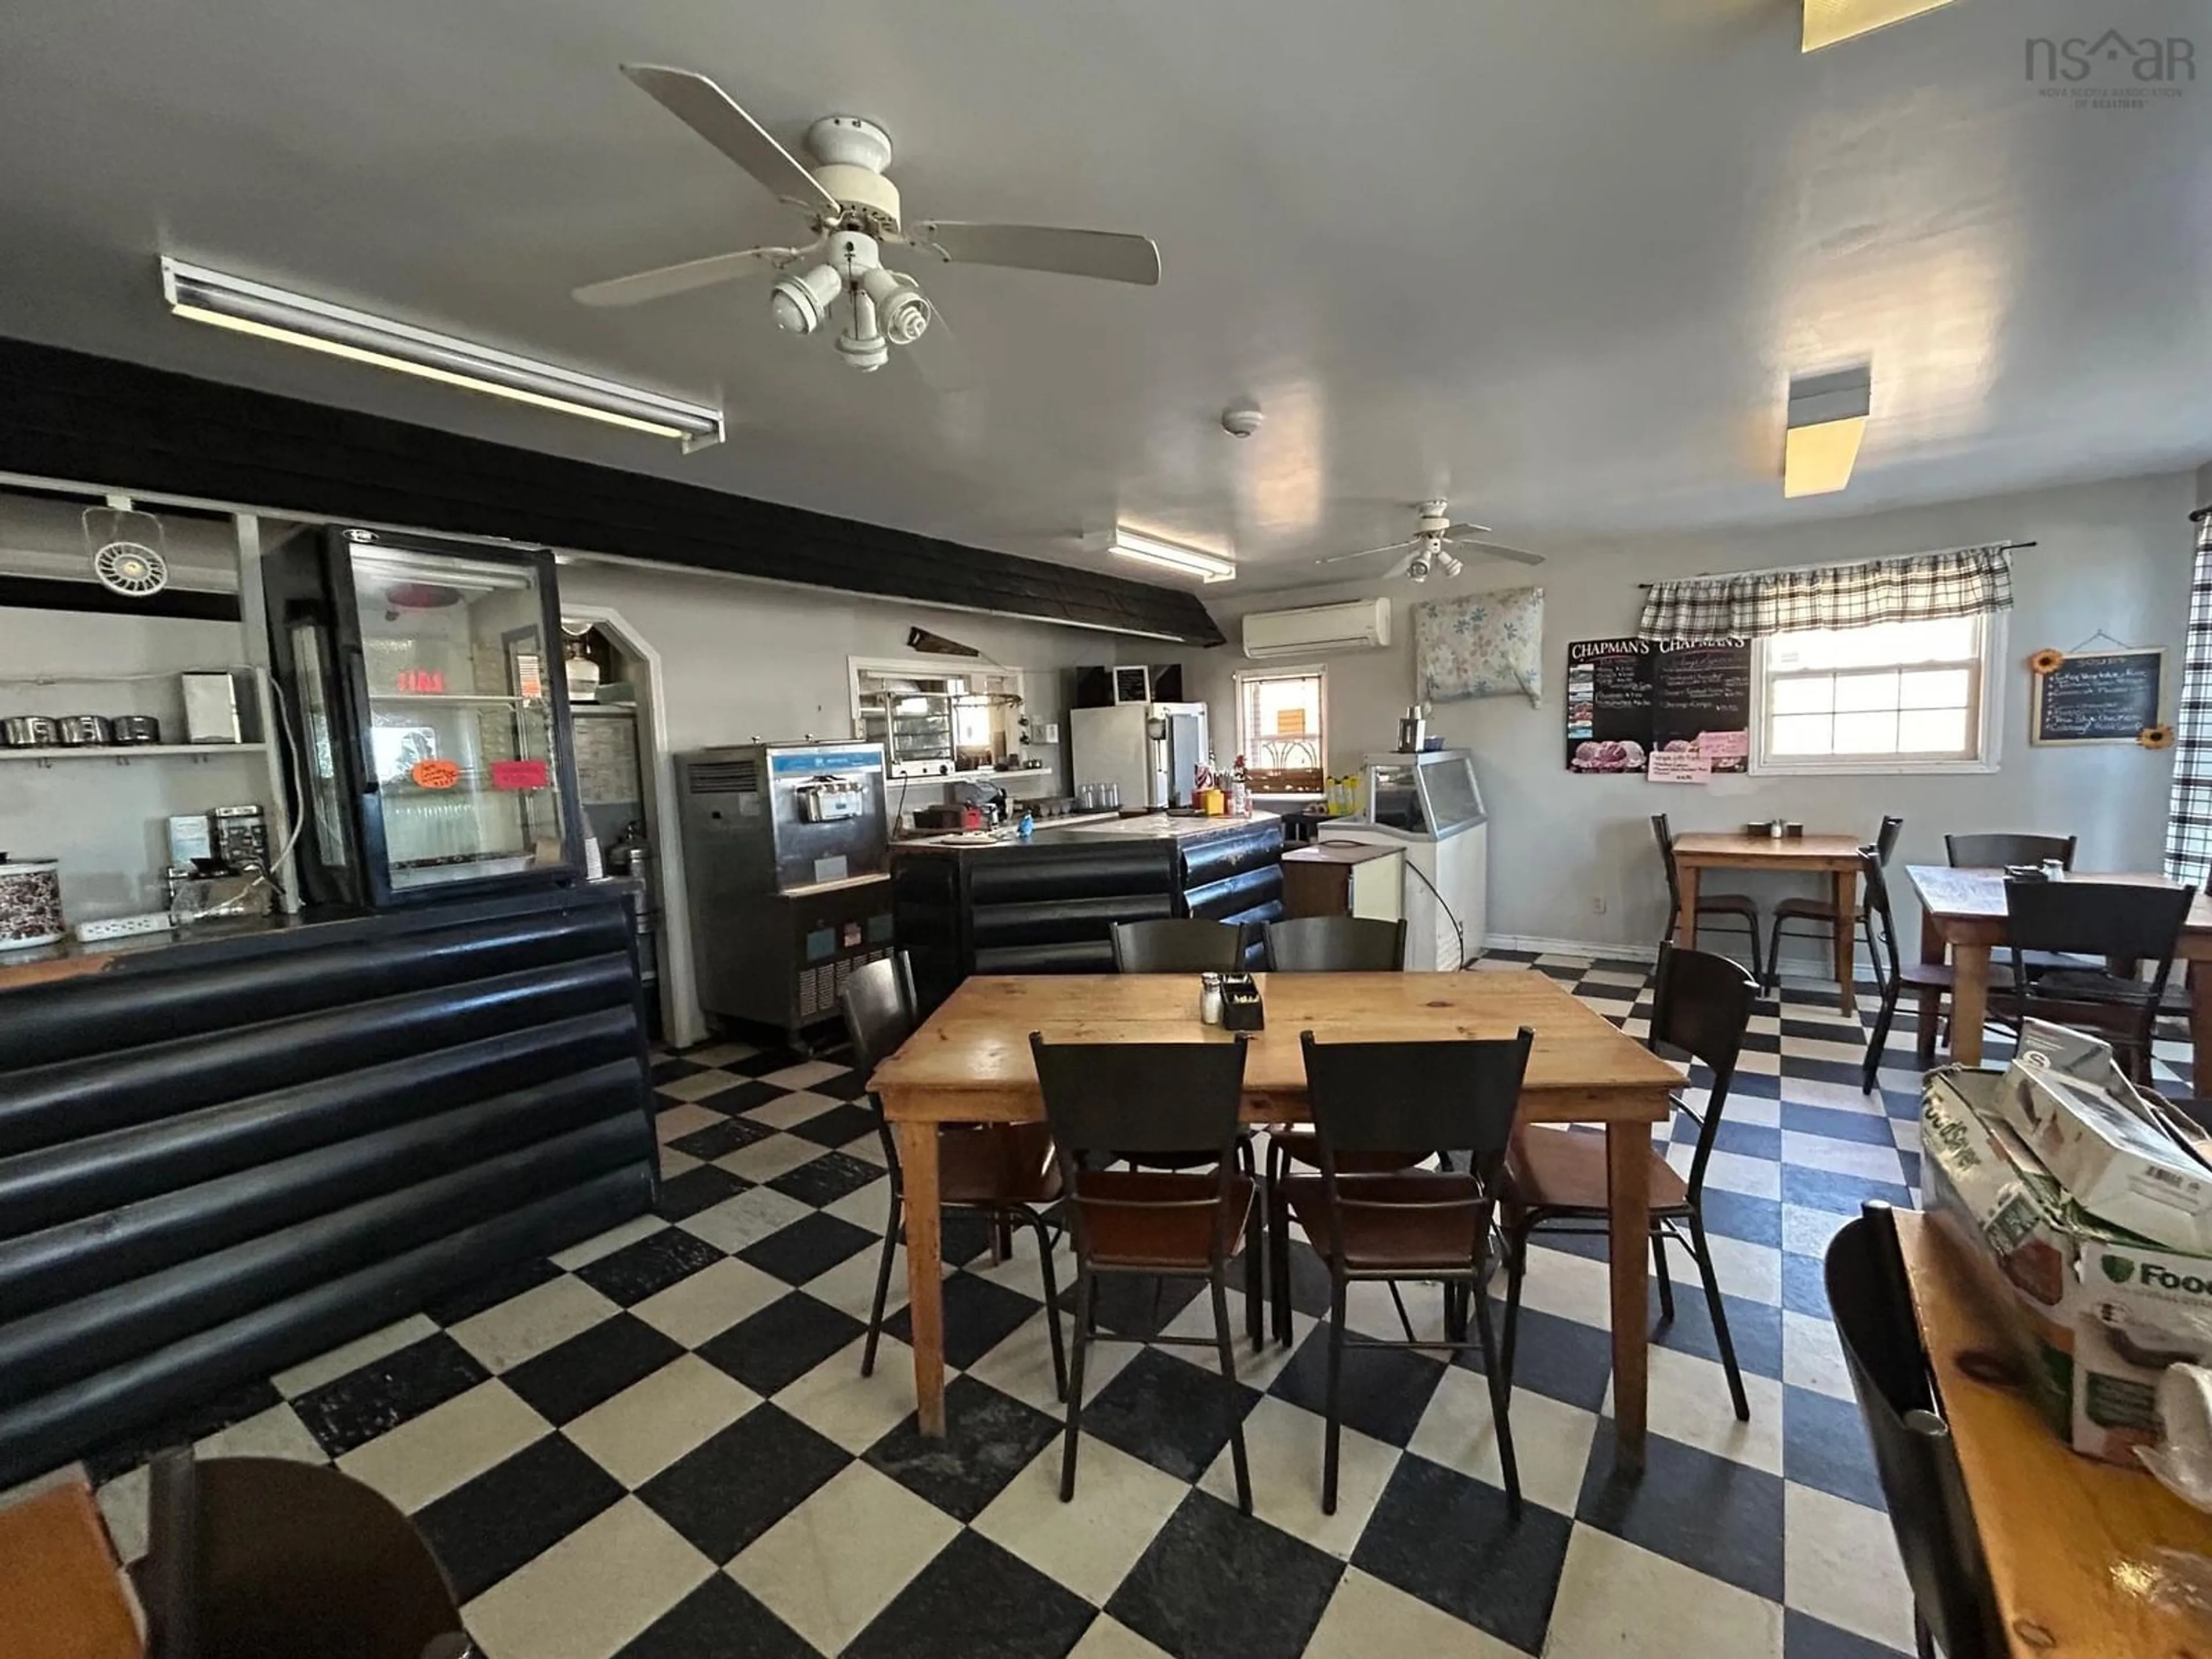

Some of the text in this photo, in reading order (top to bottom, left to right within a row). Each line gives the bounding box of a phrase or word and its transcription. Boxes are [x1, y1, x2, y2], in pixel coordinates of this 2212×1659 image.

[1572, 639, 1650, 660] CHAPMAN'S
[1659, 637, 1745, 653] CHAANS
[2141, 1262, 2212, 1296] Foo
